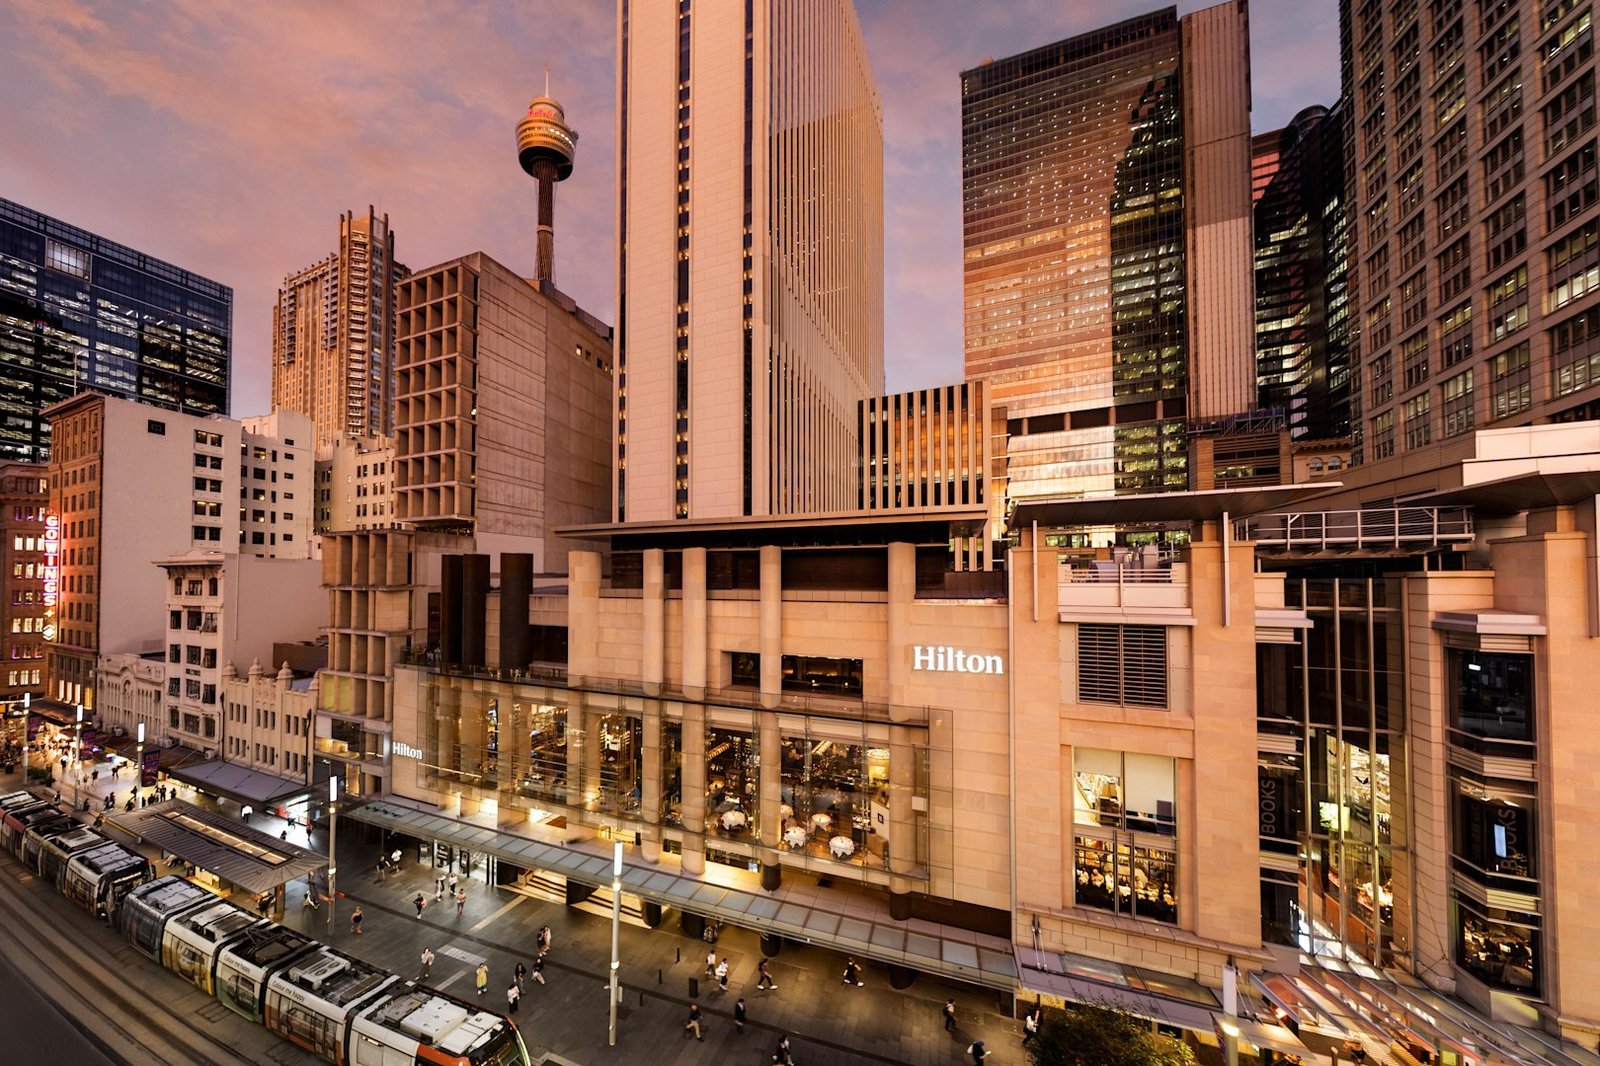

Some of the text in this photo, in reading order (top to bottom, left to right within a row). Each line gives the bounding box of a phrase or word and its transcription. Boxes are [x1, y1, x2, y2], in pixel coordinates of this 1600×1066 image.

[44, 515, 58, 606] GOWINGS
[913, 645, 1004, 674] Hilton
[392, 741, 422, 760] Hilton
[1260, 779, 1276, 834] BOOKS
